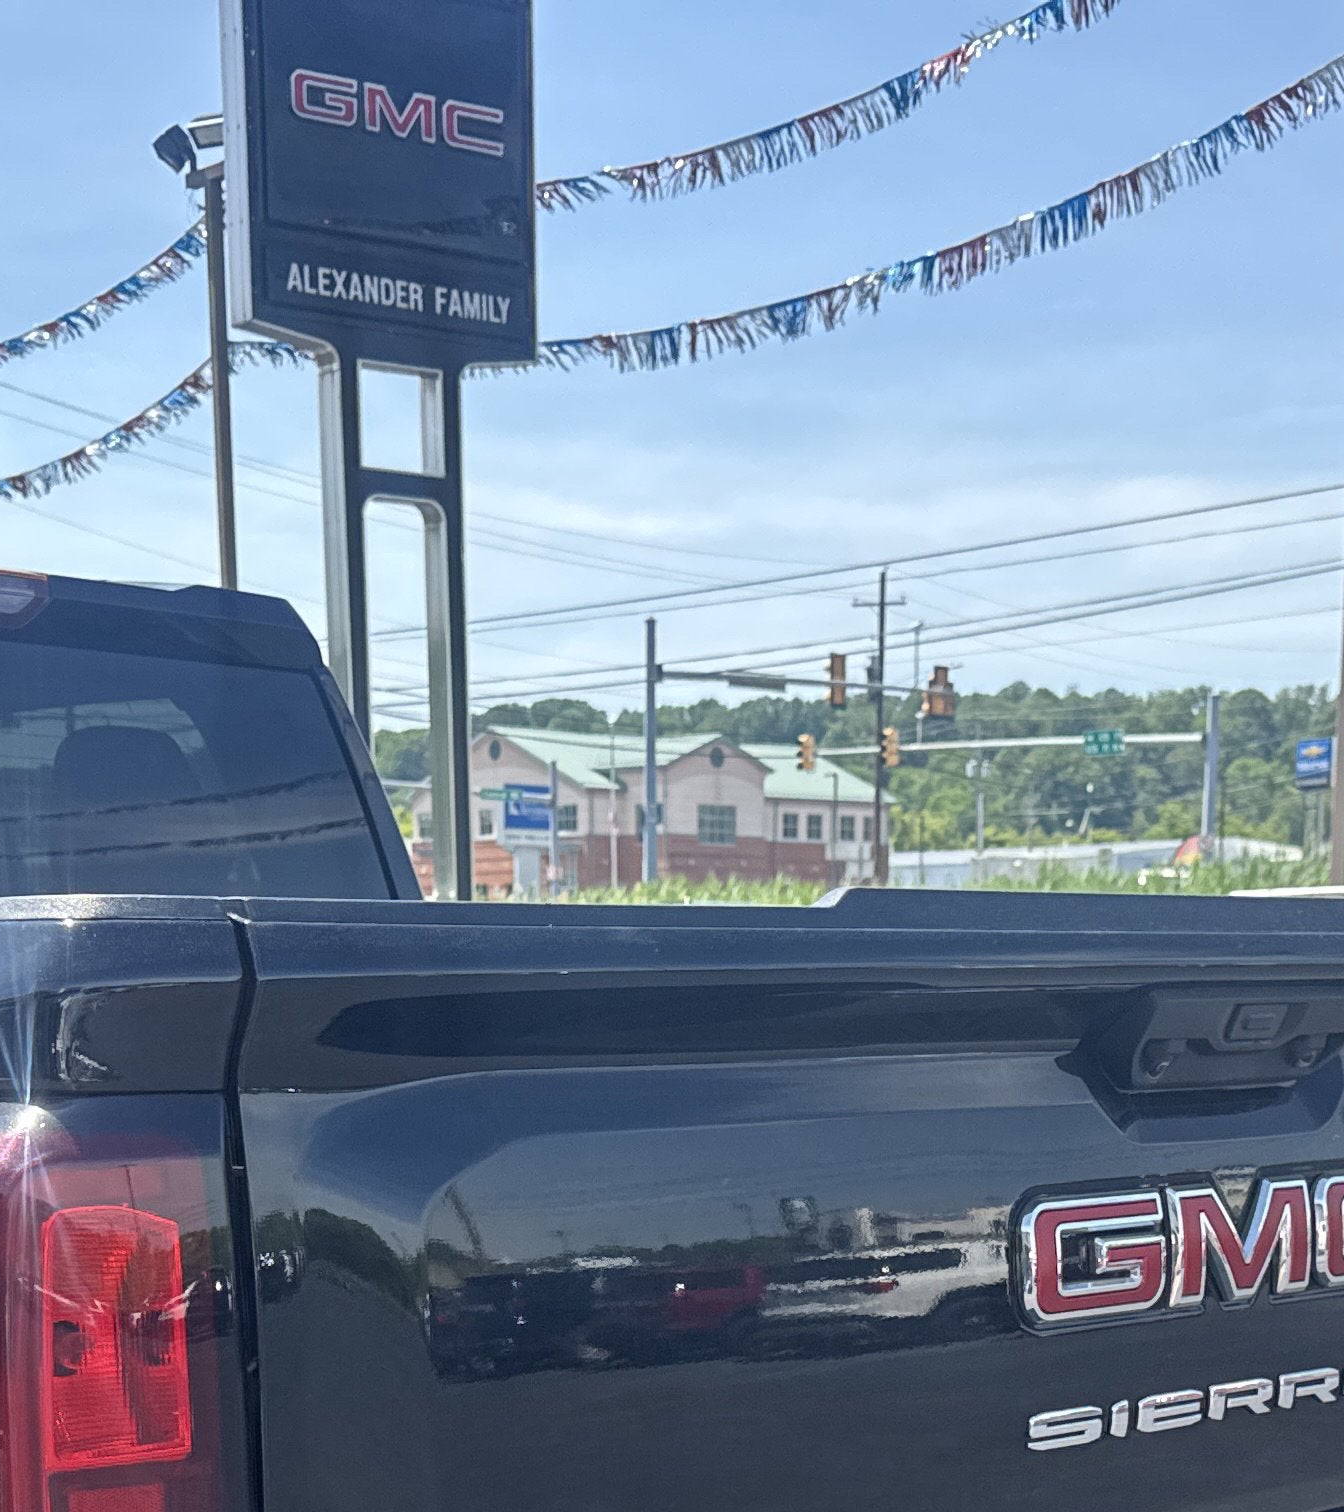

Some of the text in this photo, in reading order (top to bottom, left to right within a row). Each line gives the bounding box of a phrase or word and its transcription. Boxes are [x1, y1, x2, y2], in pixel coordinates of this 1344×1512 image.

[290, 68, 504, 156] GMC
[286, 262, 510, 325] ALEXANDER FAMILY
